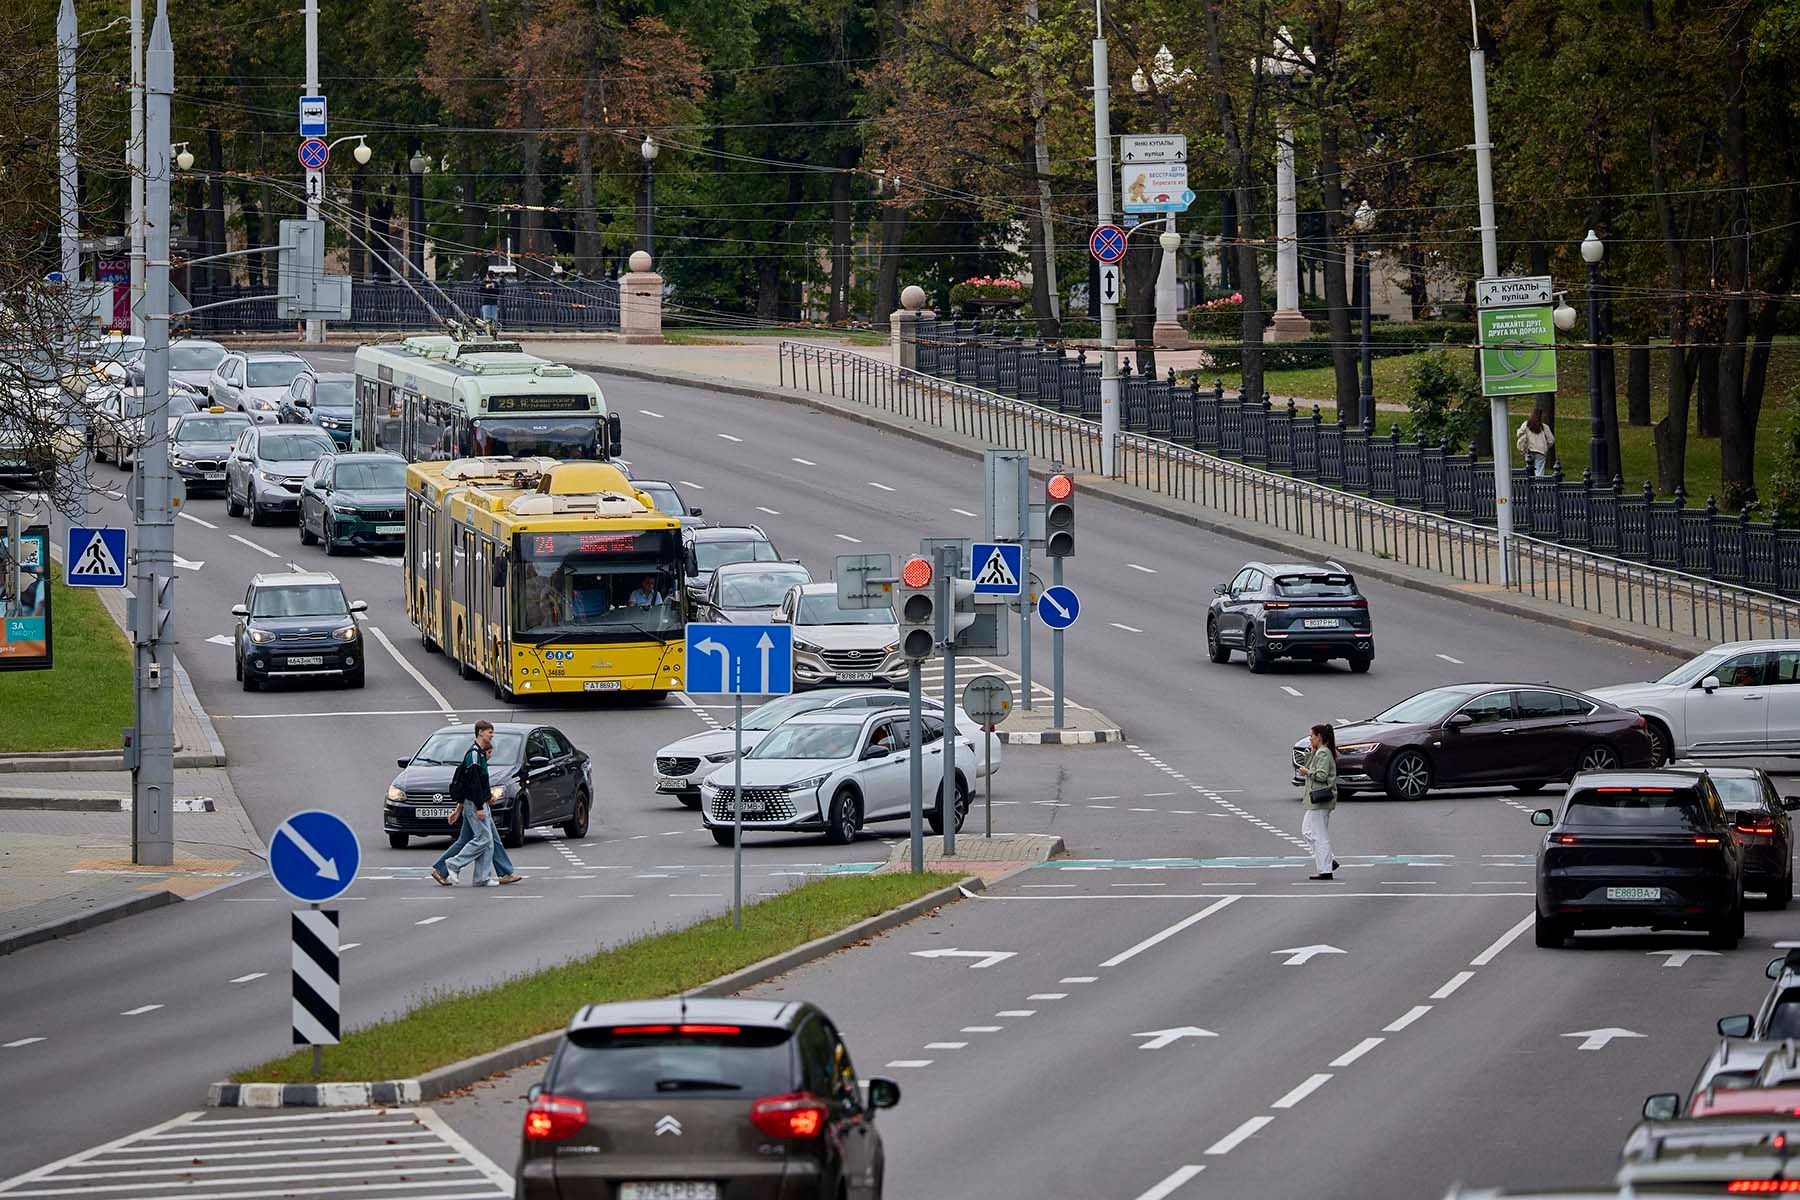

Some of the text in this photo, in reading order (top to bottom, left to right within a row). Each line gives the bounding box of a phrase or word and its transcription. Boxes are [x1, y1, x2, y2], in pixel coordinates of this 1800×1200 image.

[98, 261, 130, 270] OZO
[1501, 283, 1539, 293] КУПАЛЫ
[1526, 319, 1542, 328] ДРУГ
[1488, 328, 1509, 337] ДРУГА
[1509, 328, 1518, 336] НА
